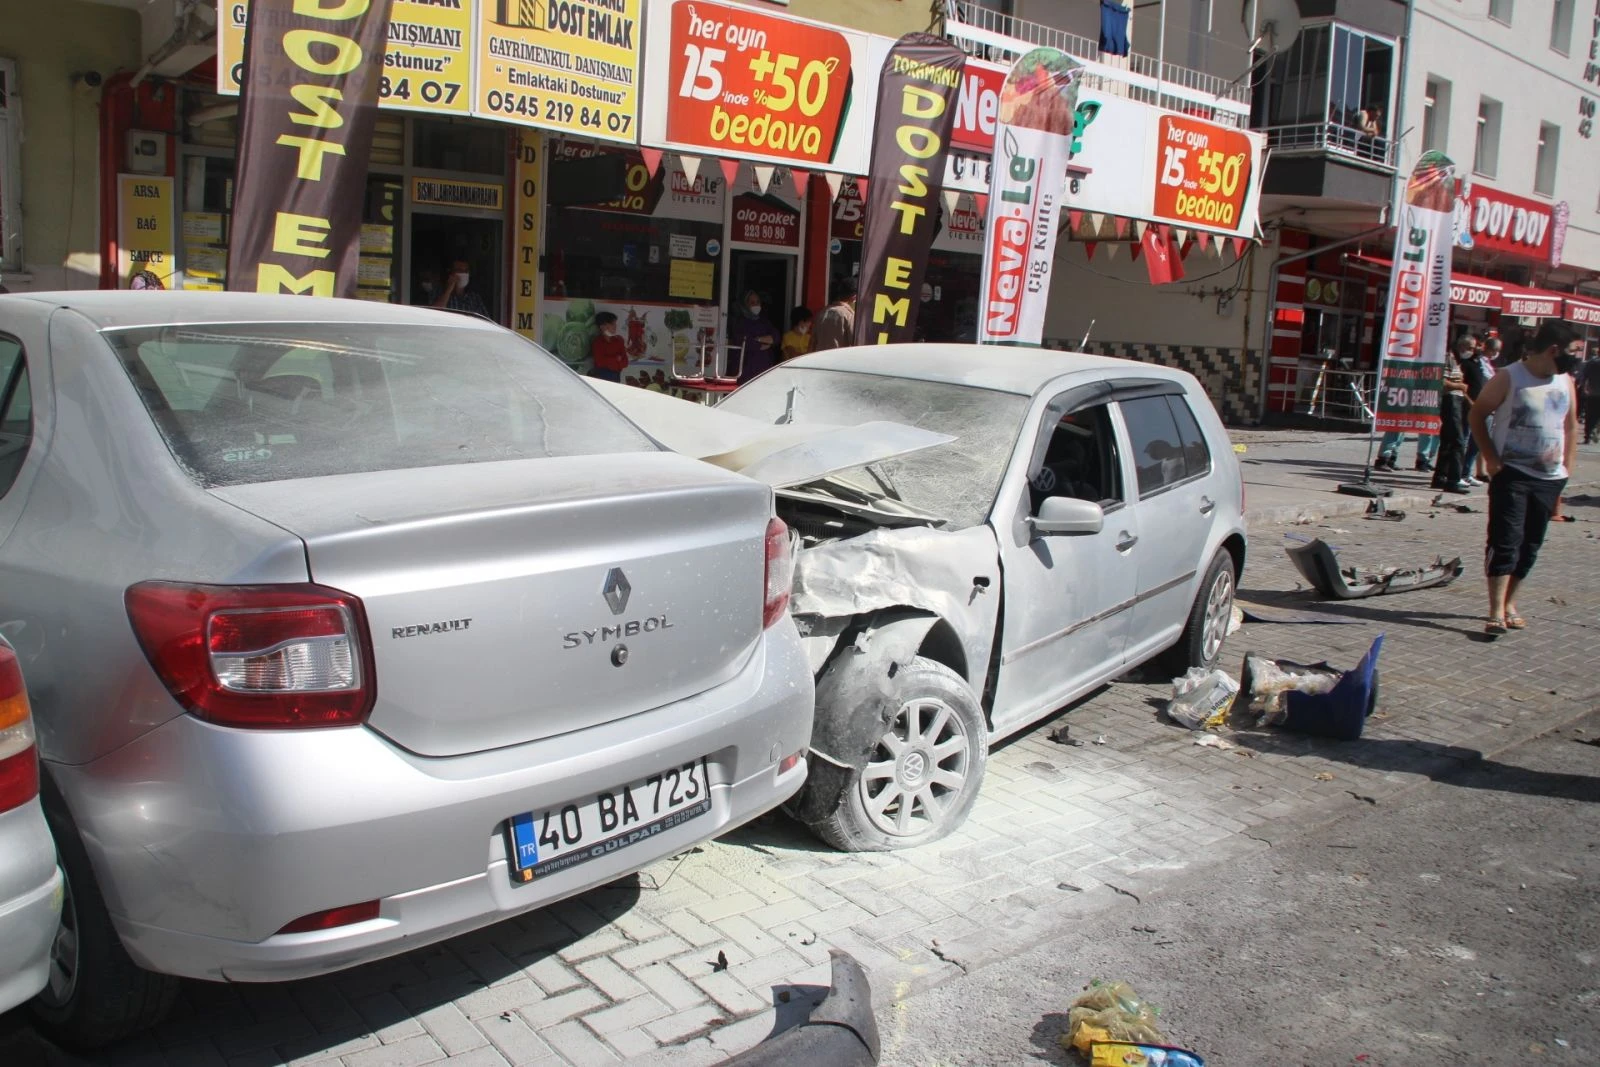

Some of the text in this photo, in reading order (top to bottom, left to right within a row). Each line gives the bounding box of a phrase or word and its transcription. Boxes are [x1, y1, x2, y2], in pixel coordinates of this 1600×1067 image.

[548, 0, 632, 50] DOST EMLAK
[688, 13, 767, 52] her ayın
[489, 36, 632, 84] GAYRİMENKUL DANIŞMANI
[894, 54, 960, 89] TORAMANLI
[378, 76, 410, 100] 84
[421, 81, 461, 104] 07
[508, 68, 568, 93] Emlaktaki
[487, 90, 632, 133] 0545 219 84 07
[710, 105, 821, 155] bedava
[1168, 124, 1185, 143] her
[133, 185, 160, 198] ARSA
[1175, 189, 1234, 224] bedava
[137, 215, 156, 230] BAĞ
[736, 208, 796, 227] alo paket
[744, 223, 786, 240] 223 80 80
[1475, 197, 1550, 246] DOY DOY
[130, 249, 163, 264] BAHÇE
[1468, 289, 1490, 304] DOY
[392, 618, 472, 639] RENAULT
[563, 614, 674, 650] SYMBOL
[539, 804, 582, 850] 40
[597, 786, 640, 833] BA
[646, 761, 700, 814] 723
[520, 845, 535, 859] TR
[591, 823, 662, 858] GÜLPAR
